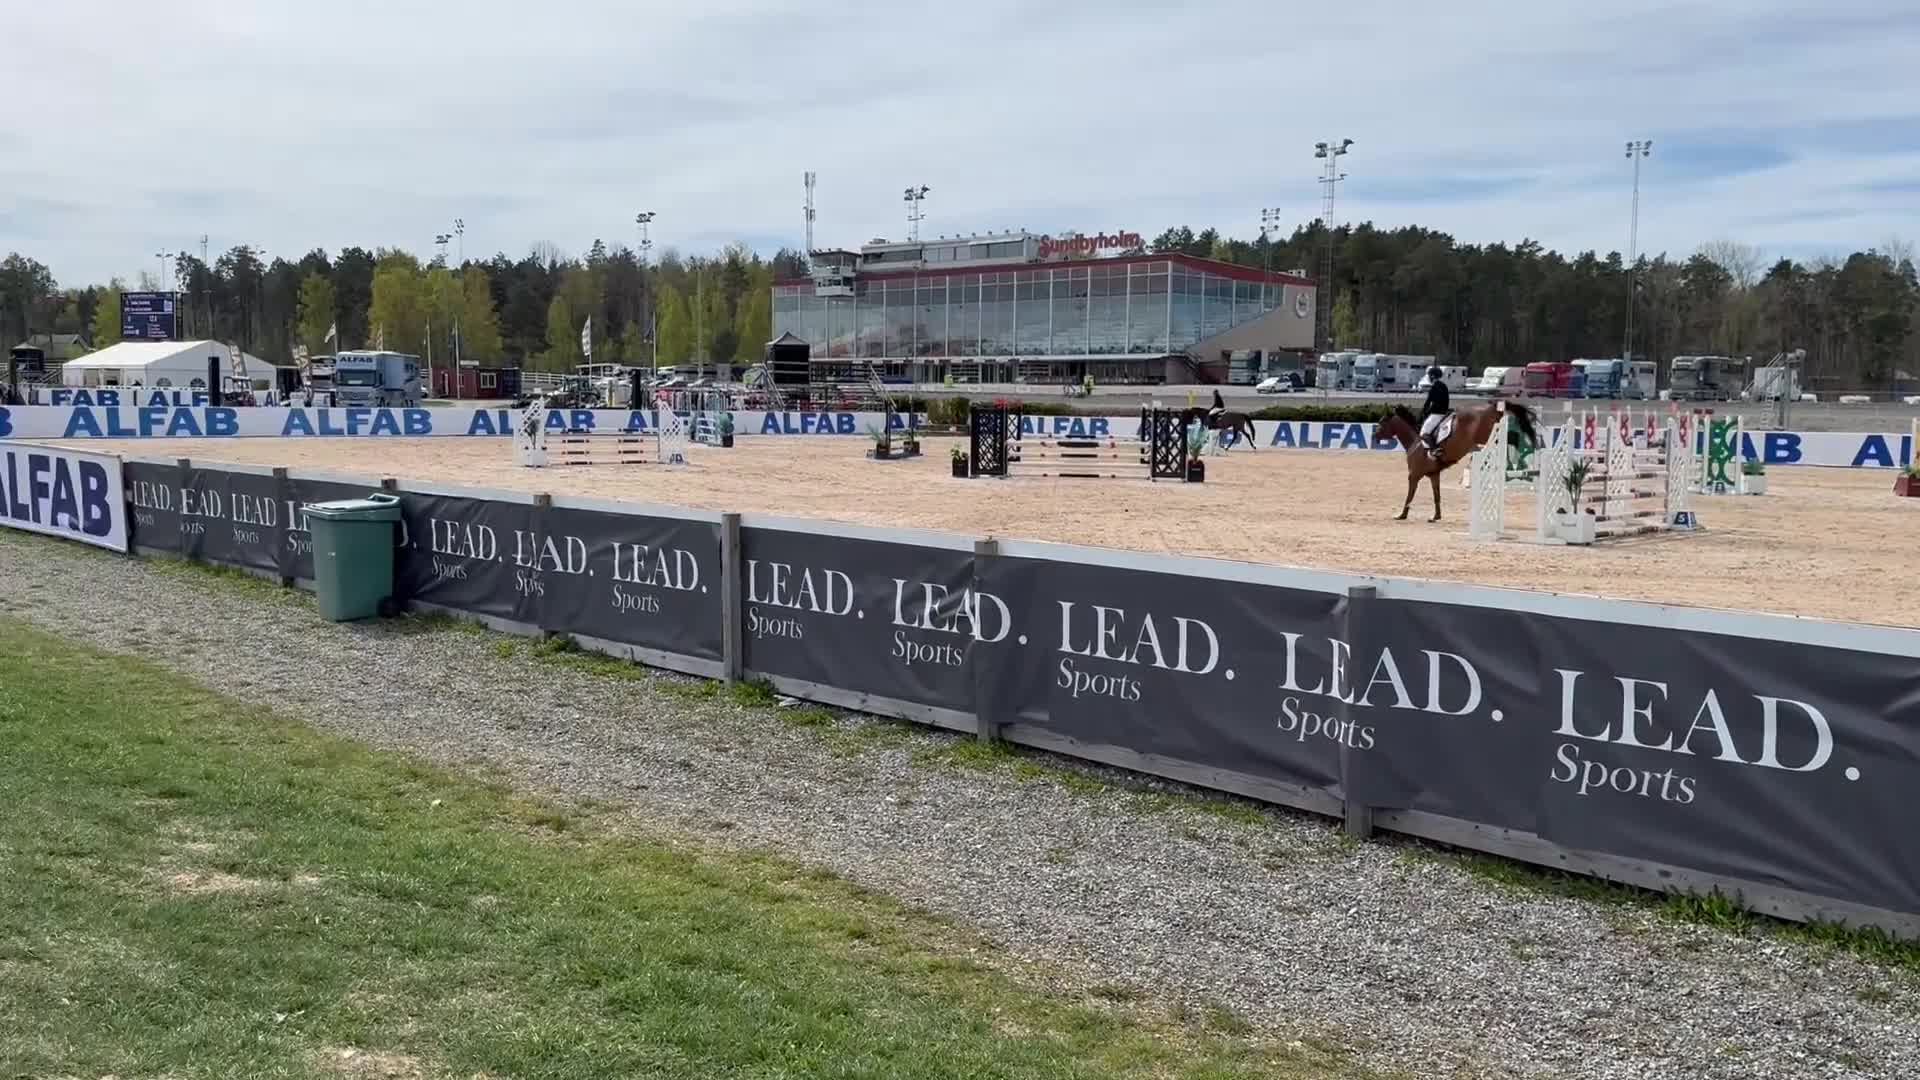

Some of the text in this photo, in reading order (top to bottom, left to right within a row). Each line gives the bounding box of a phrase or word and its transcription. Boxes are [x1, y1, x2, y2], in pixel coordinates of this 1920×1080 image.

[1039, 230, 1140, 257] Sundbyholm
[339, 356, 373, 364] ALFAB
[64, 407, 239, 436] ALFAB
[282, 408, 432, 435] ALFAB
[468, 409, 596, 434] ALAB
[761, 412, 856, 434] ALFAB
[430, 518, 503, 562] LEAD.
[431, 555, 468, 581] Sports
[612, 542, 707, 593] LEAD.
[611, 584, 660, 613] Sports
[747, 559, 865, 620] LEAD.
[747, 607, 804, 640] Sports
[892, 578, 1028, 645] LEAD.
[892, 631, 963, 667] Sports
[1057, 600, 1236, 681] LEAD.
[1057, 659, 1142, 701] Sports
[1279, 631, 1505, 722] LEAD.
[1277, 697, 1377, 750] Sports
[1552, 667, 1860, 781] LEAD.
[1550, 743, 1697, 804] Sports
